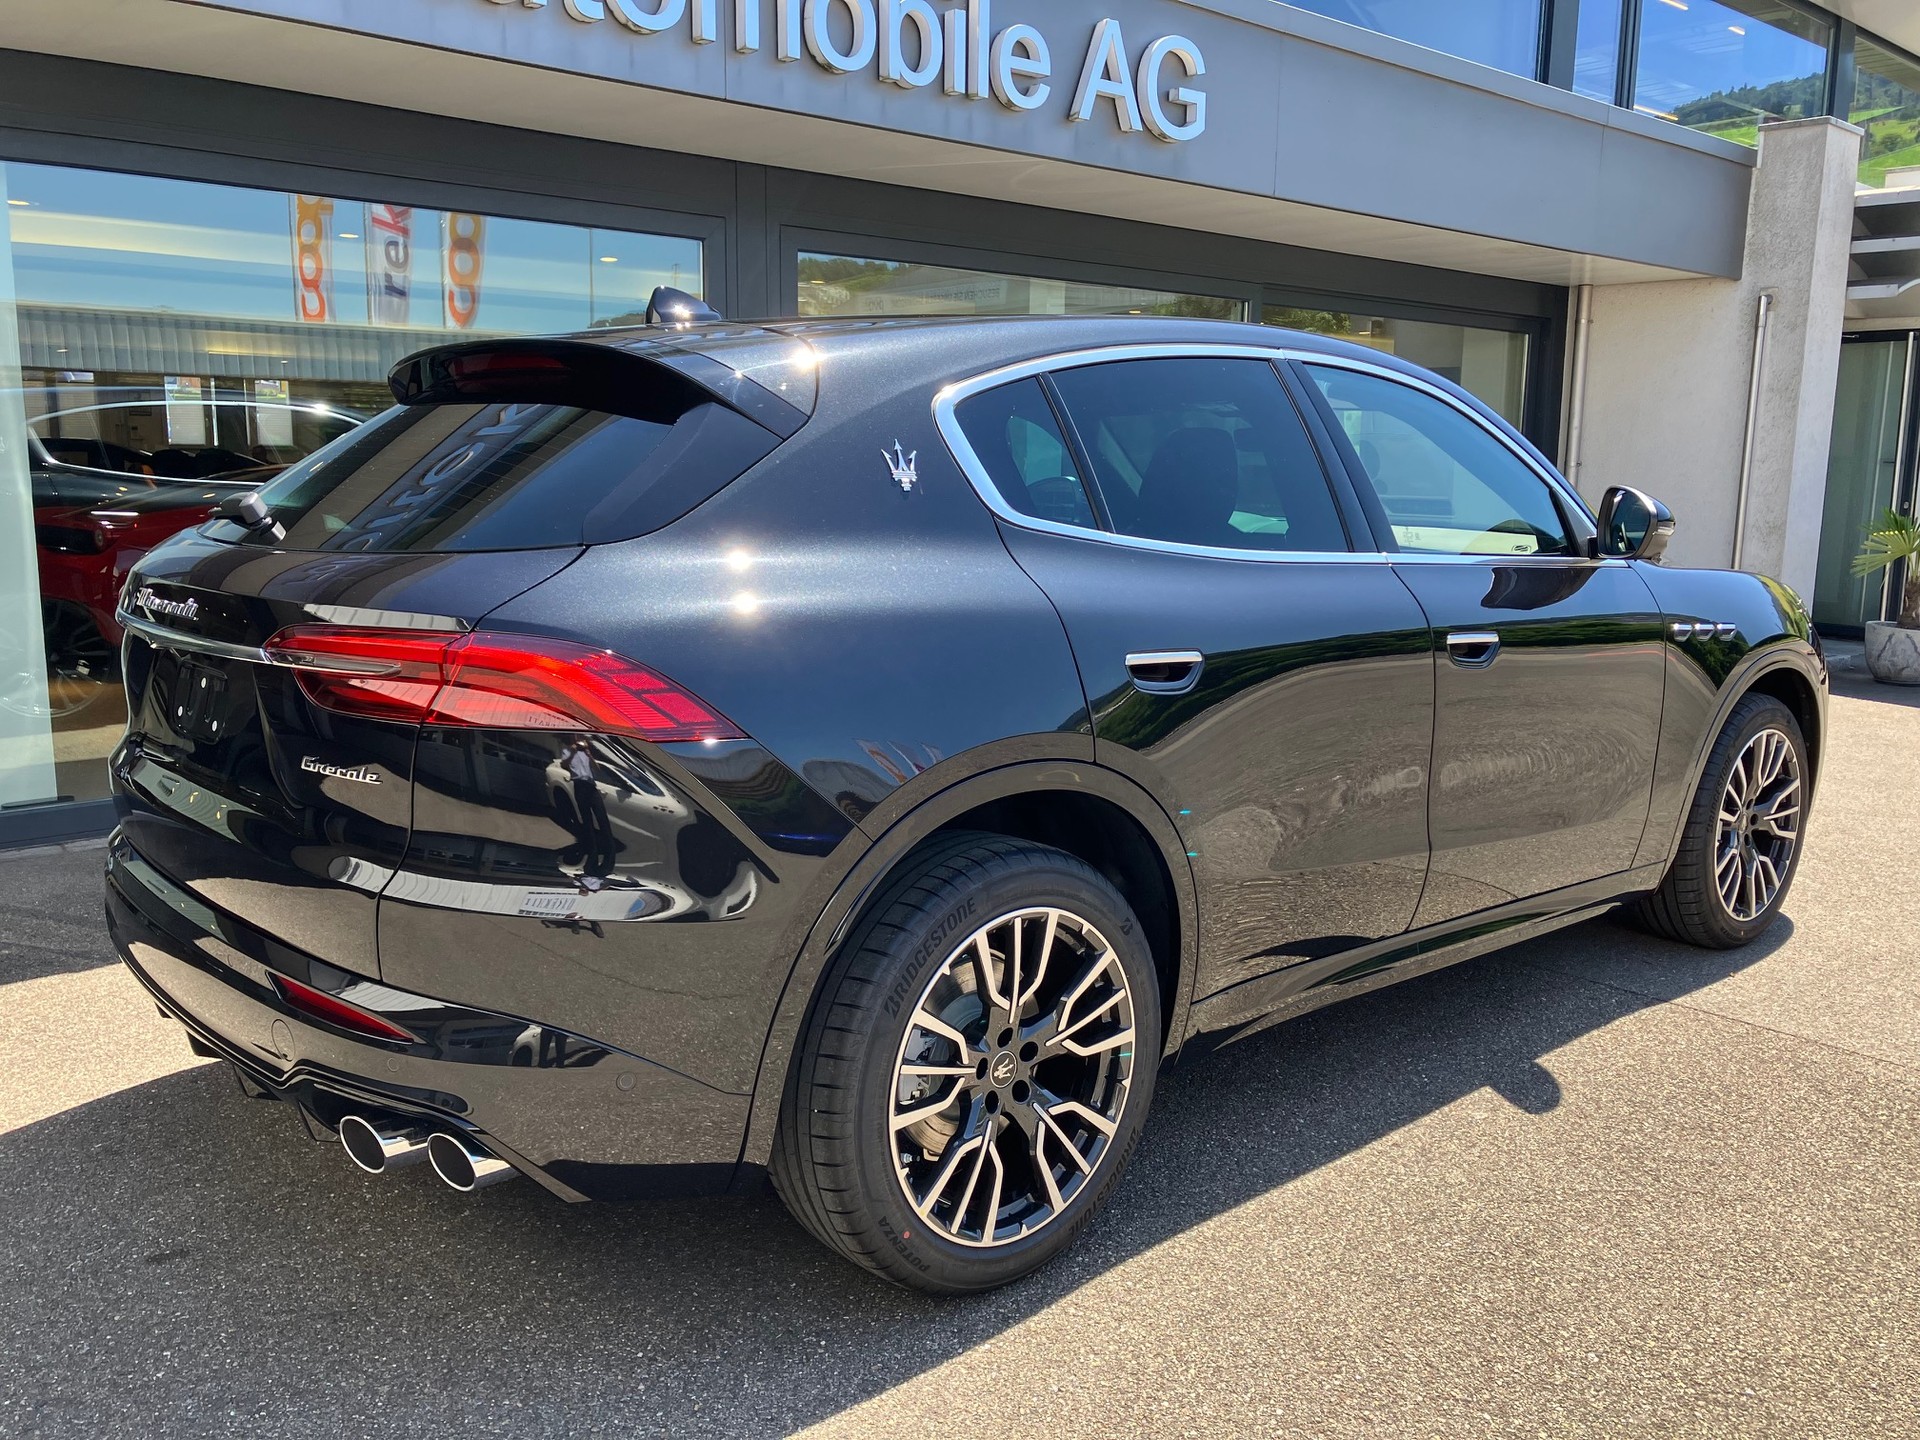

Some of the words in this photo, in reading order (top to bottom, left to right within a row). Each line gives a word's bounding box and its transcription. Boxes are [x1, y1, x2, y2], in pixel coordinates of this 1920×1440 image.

[1069, 18, 1207, 143] AG
[300, 755, 384, 785] Grecale
[1706, 752, 1734, 833] BRIDGESTONE
[883, 897, 977, 1021] BRIDGESTONE
[877, 1215, 932, 1272] POTENZA
